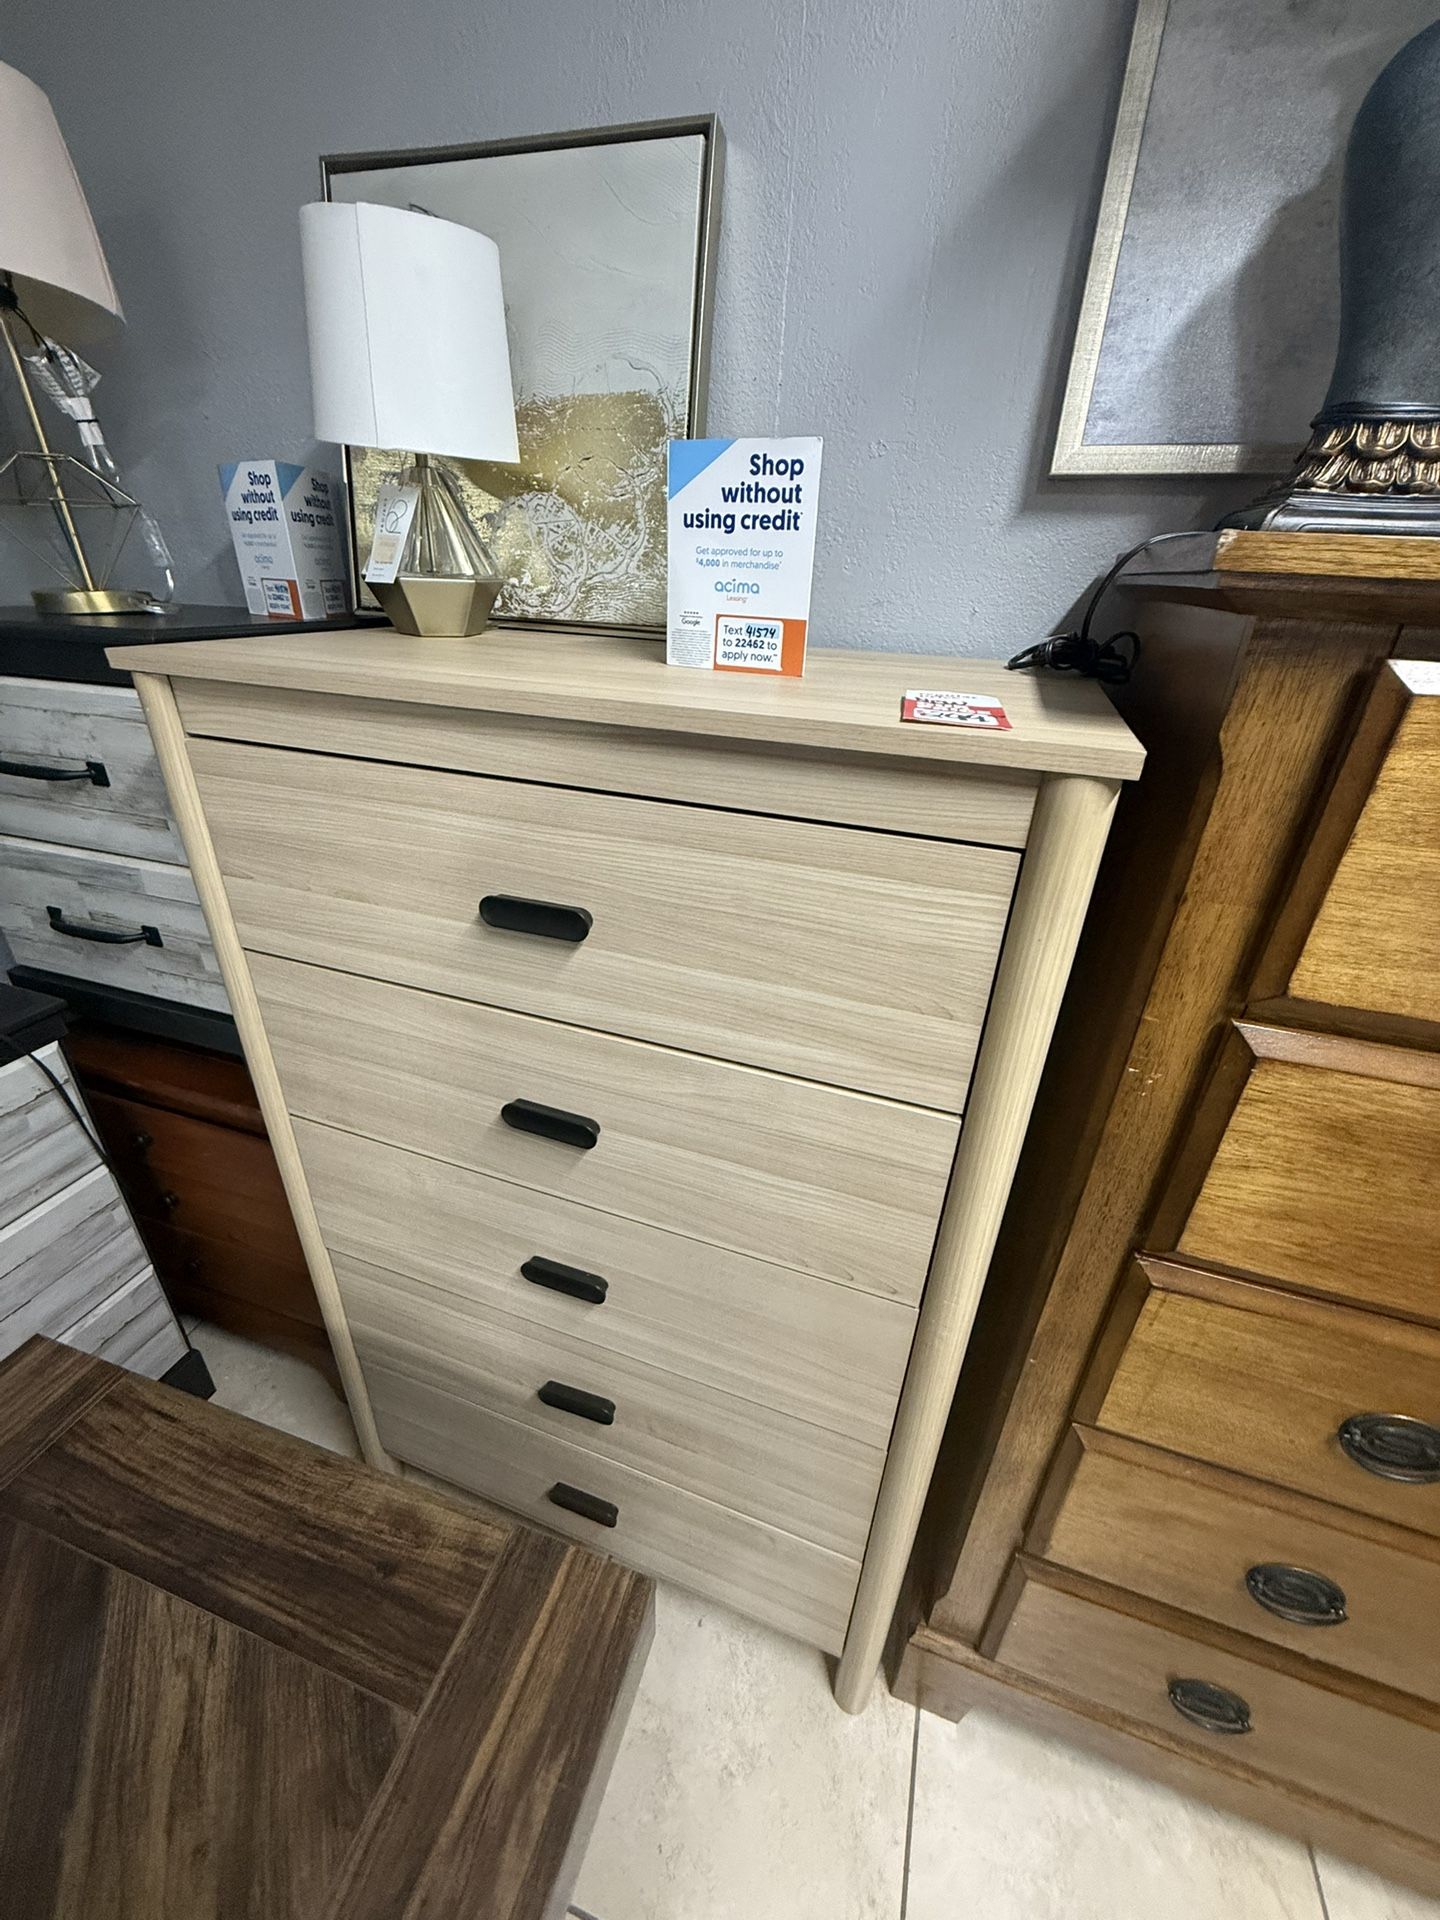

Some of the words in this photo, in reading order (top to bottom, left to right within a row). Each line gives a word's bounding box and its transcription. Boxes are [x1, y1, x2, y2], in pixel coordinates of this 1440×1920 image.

[750, 453, 804, 481] Shop
[247, 471, 271, 488] Shop
[241, 489, 276, 504] without
[721, 481, 803, 504] without
[232, 508, 253, 524] using
[254, 507, 279, 521] credit
[290, 509, 316, 527] using
[683, 508, 736, 534] using
[696, 545, 709, 555] Get
[711, 548, 748, 560] approved
[749, 548, 761, 557] for
[763, 550, 773, 558] up
[774, 549, 784, 558] to
[722, 560, 729, 568] in
[714, 578, 760, 594] acima
[681, 617, 701, 627] Google
[723, 625, 743, 636] Text
[723, 638, 733, 648] to
[735, 638, 765, 650] 22462
[767, 641, 778, 651] to
[721, 650, 748, 662] apply
